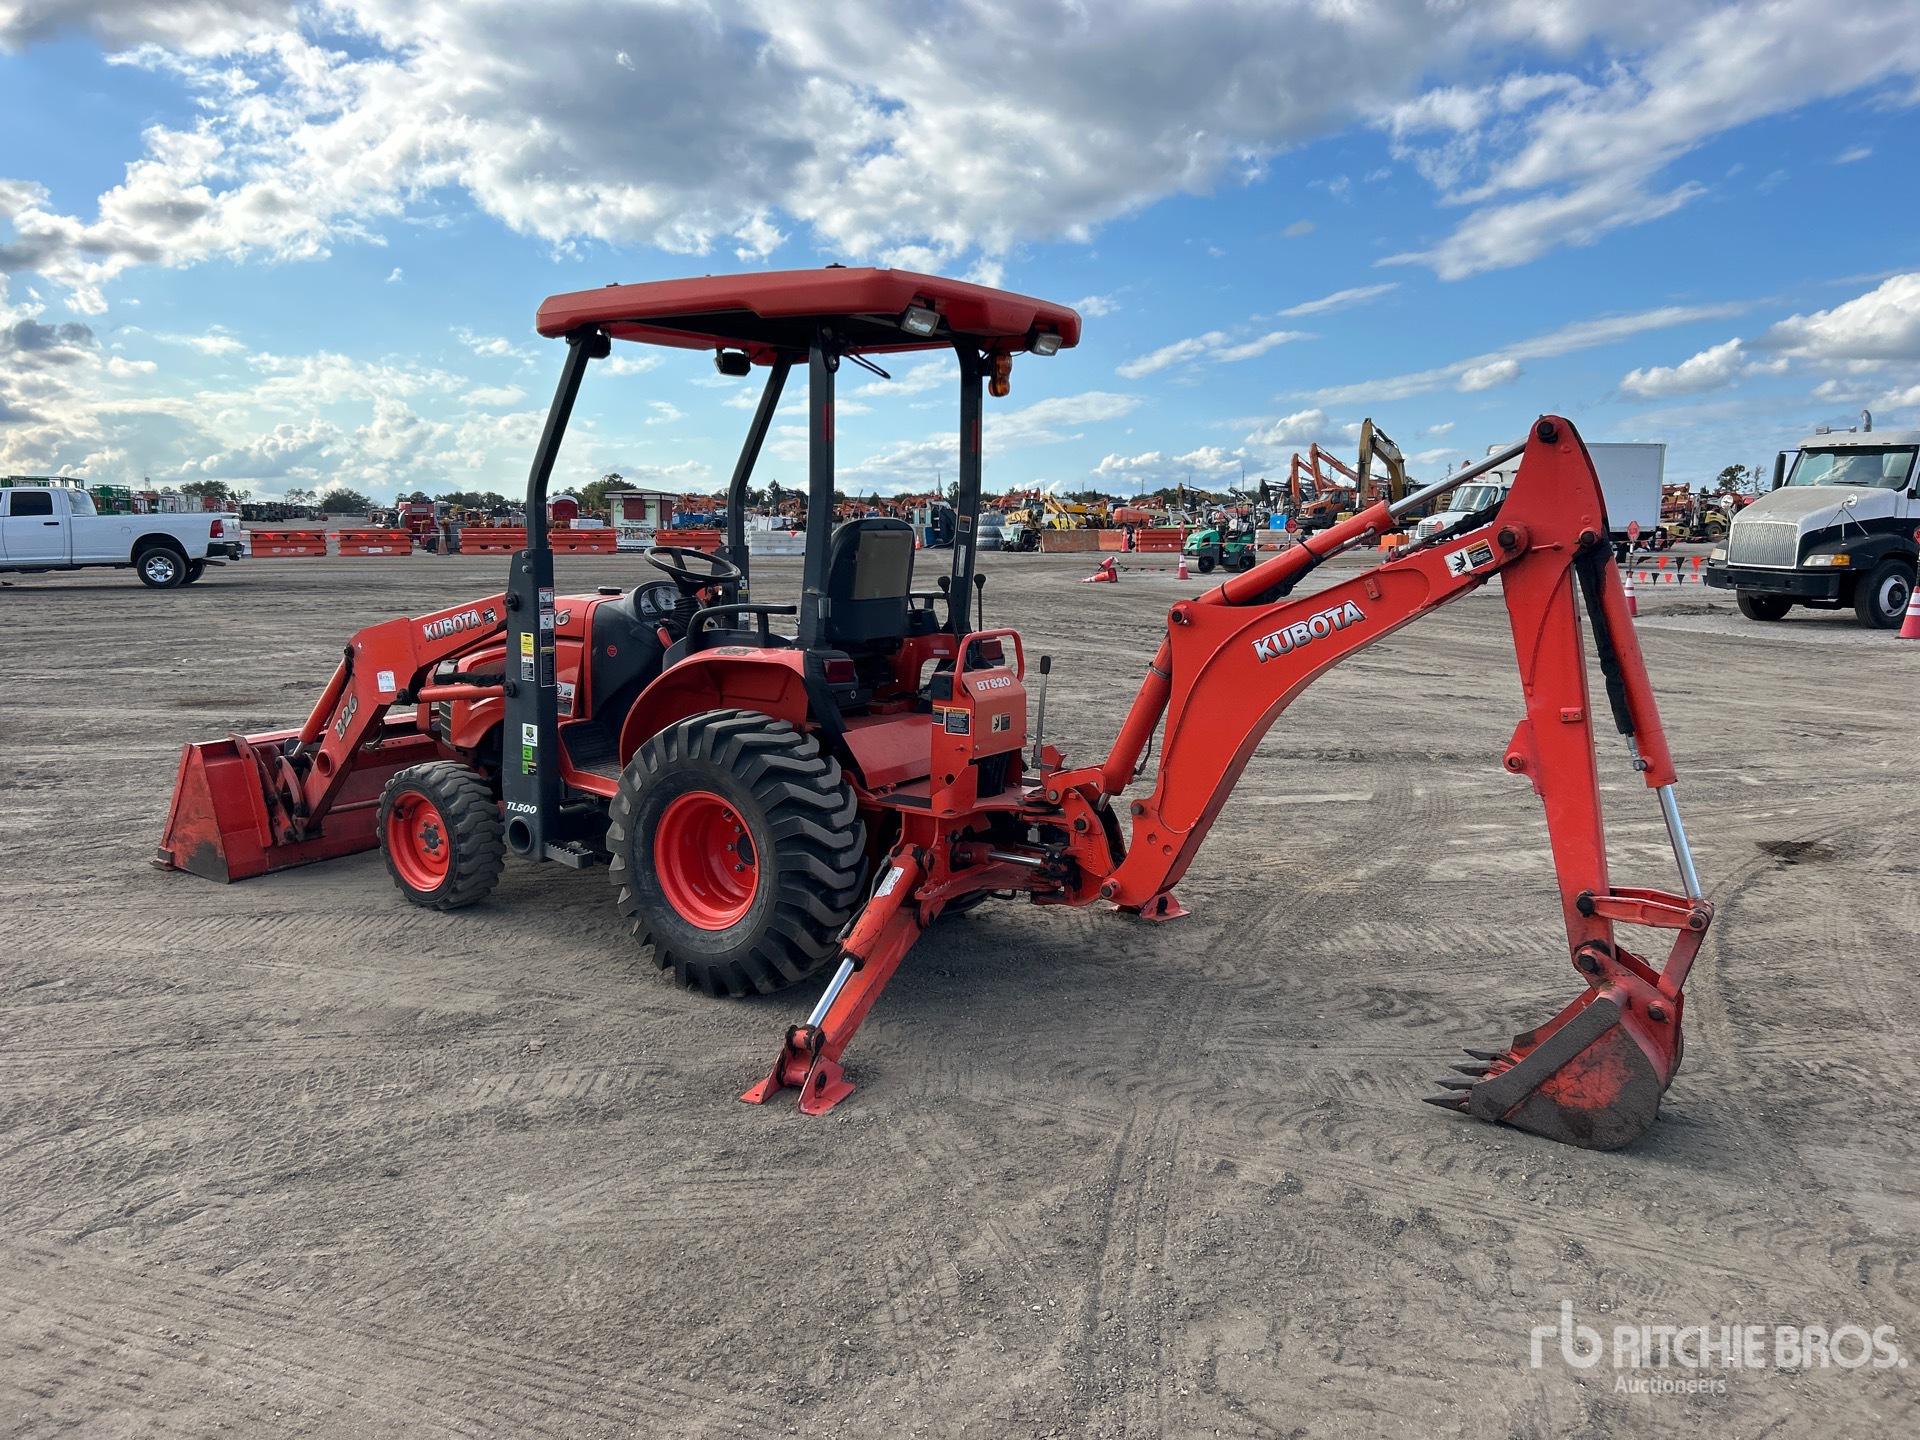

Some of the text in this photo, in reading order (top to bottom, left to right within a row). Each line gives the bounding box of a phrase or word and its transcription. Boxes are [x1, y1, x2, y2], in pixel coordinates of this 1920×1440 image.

[423, 609, 481, 641] KUBOTA
[1251, 600, 1366, 662] KUBOTA
[976, 677, 1011, 690] BT820
[335, 693, 358, 740] B26
[506, 801, 537, 814] TL500
